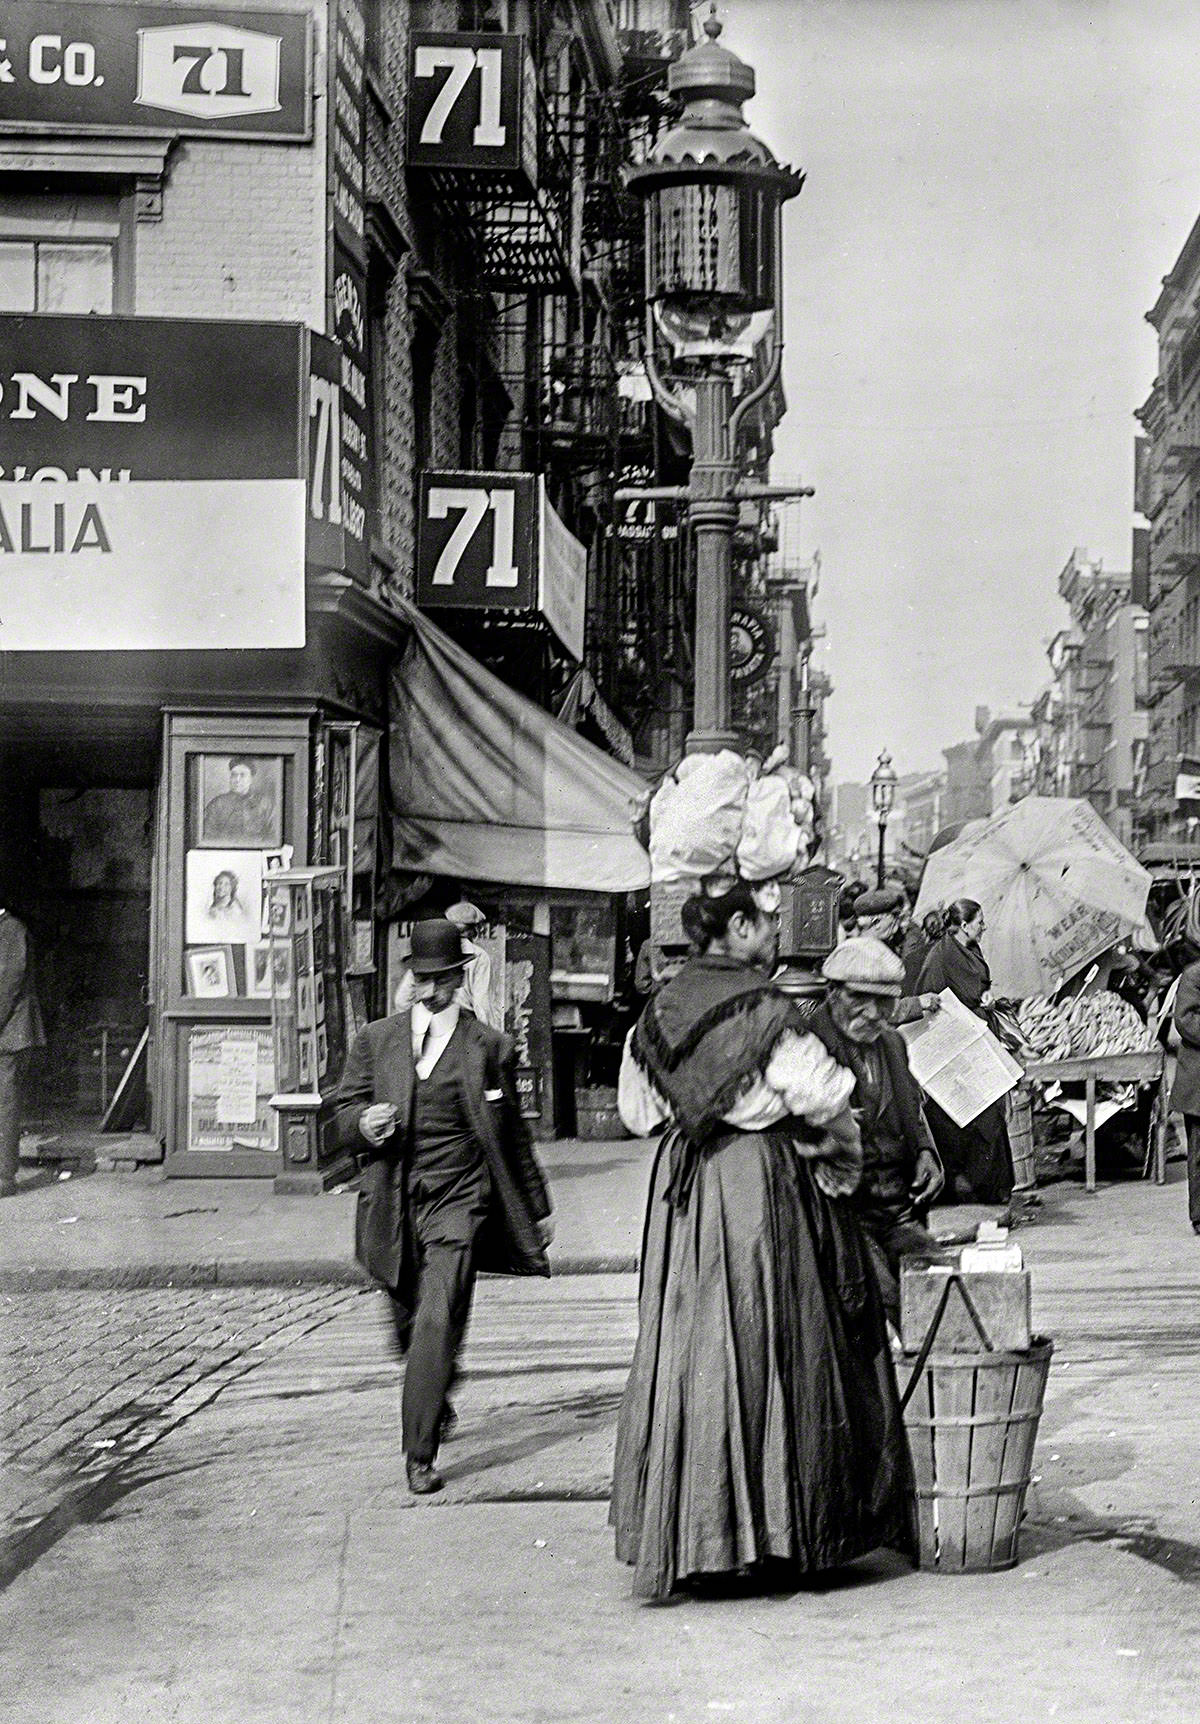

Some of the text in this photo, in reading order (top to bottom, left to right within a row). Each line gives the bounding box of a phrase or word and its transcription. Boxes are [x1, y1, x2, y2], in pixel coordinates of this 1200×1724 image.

[173, 46, 251, 96] 71
[415, 46, 506, 146] 71
[0, 372, 147, 422] NE
[309, 373, 342, 524] 71
[428, 488, 519, 587] 71
